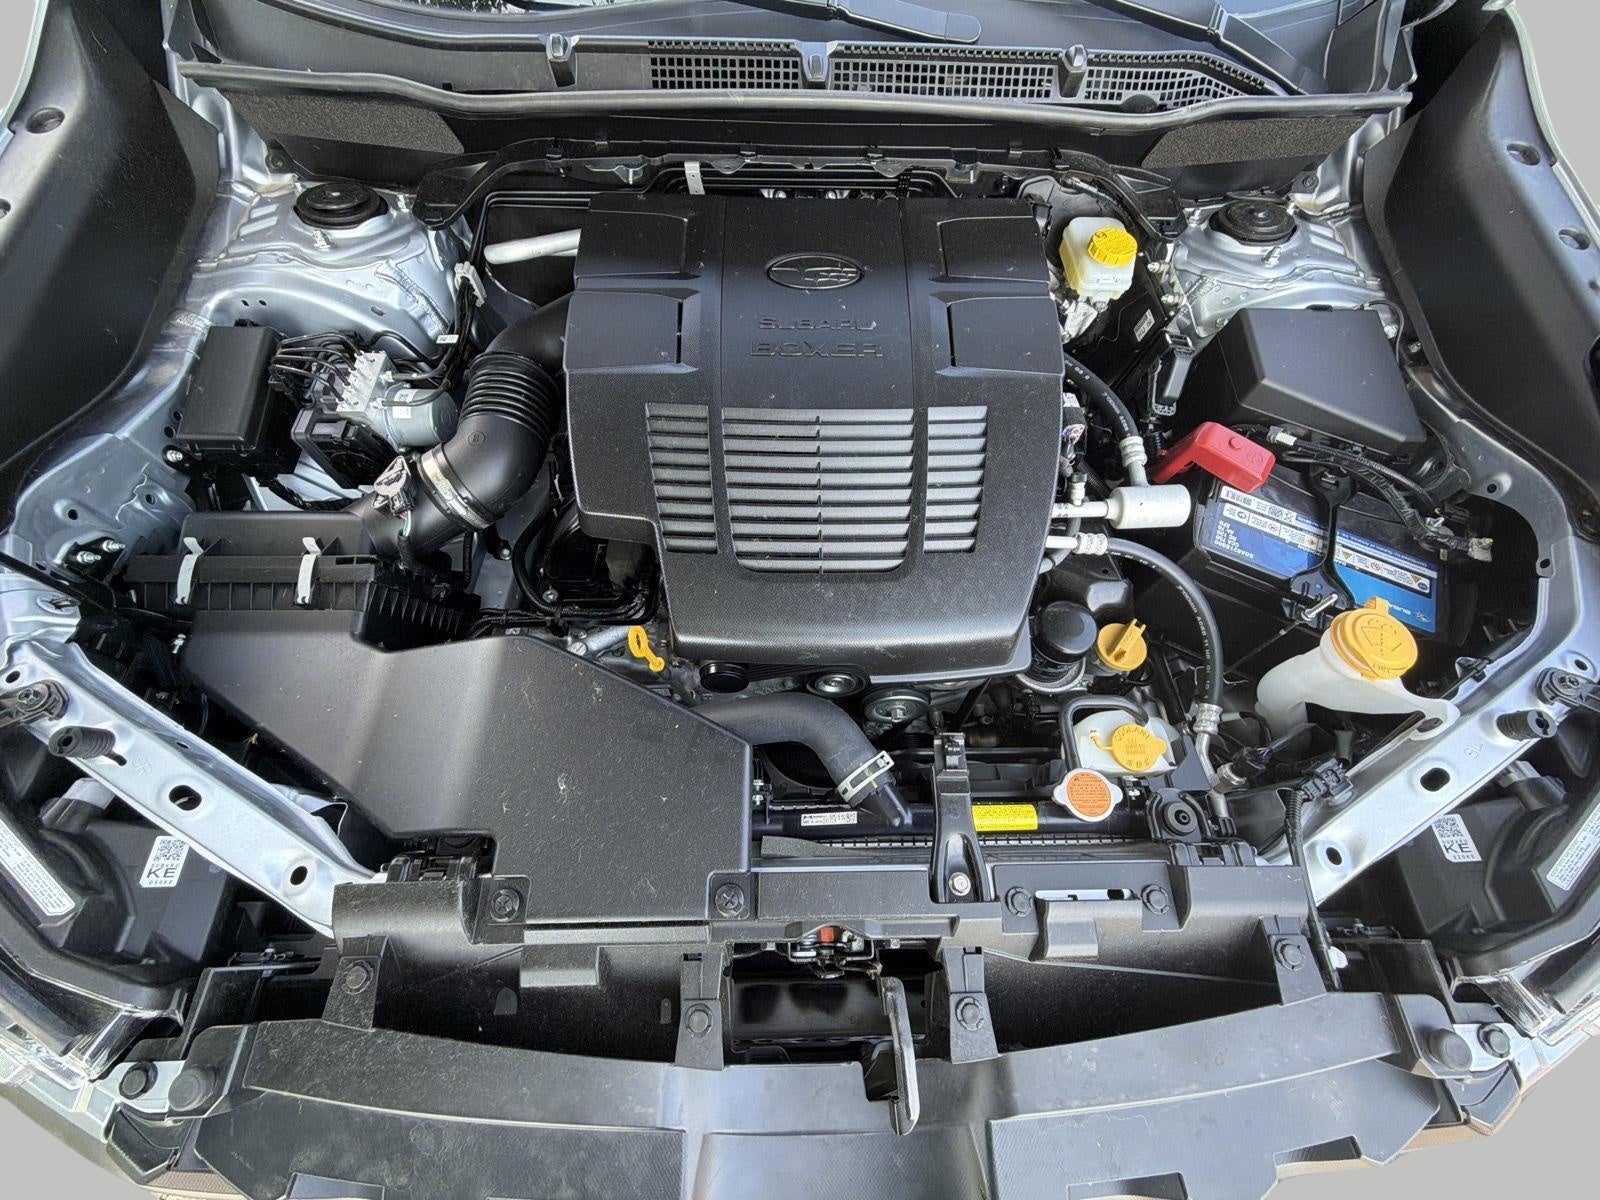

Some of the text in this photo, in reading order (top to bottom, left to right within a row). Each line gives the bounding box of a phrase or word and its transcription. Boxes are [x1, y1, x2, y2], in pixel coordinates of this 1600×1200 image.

[759, 318, 876, 330] SUBARU
[751, 341, 882, 357] BOXER
[1389, 604, 1412, 615] SUBA
[1114, 725, 1150, 742] COOLANT
[1444, 843, 1472, 854] KE
[146, 867, 177, 878] KE
